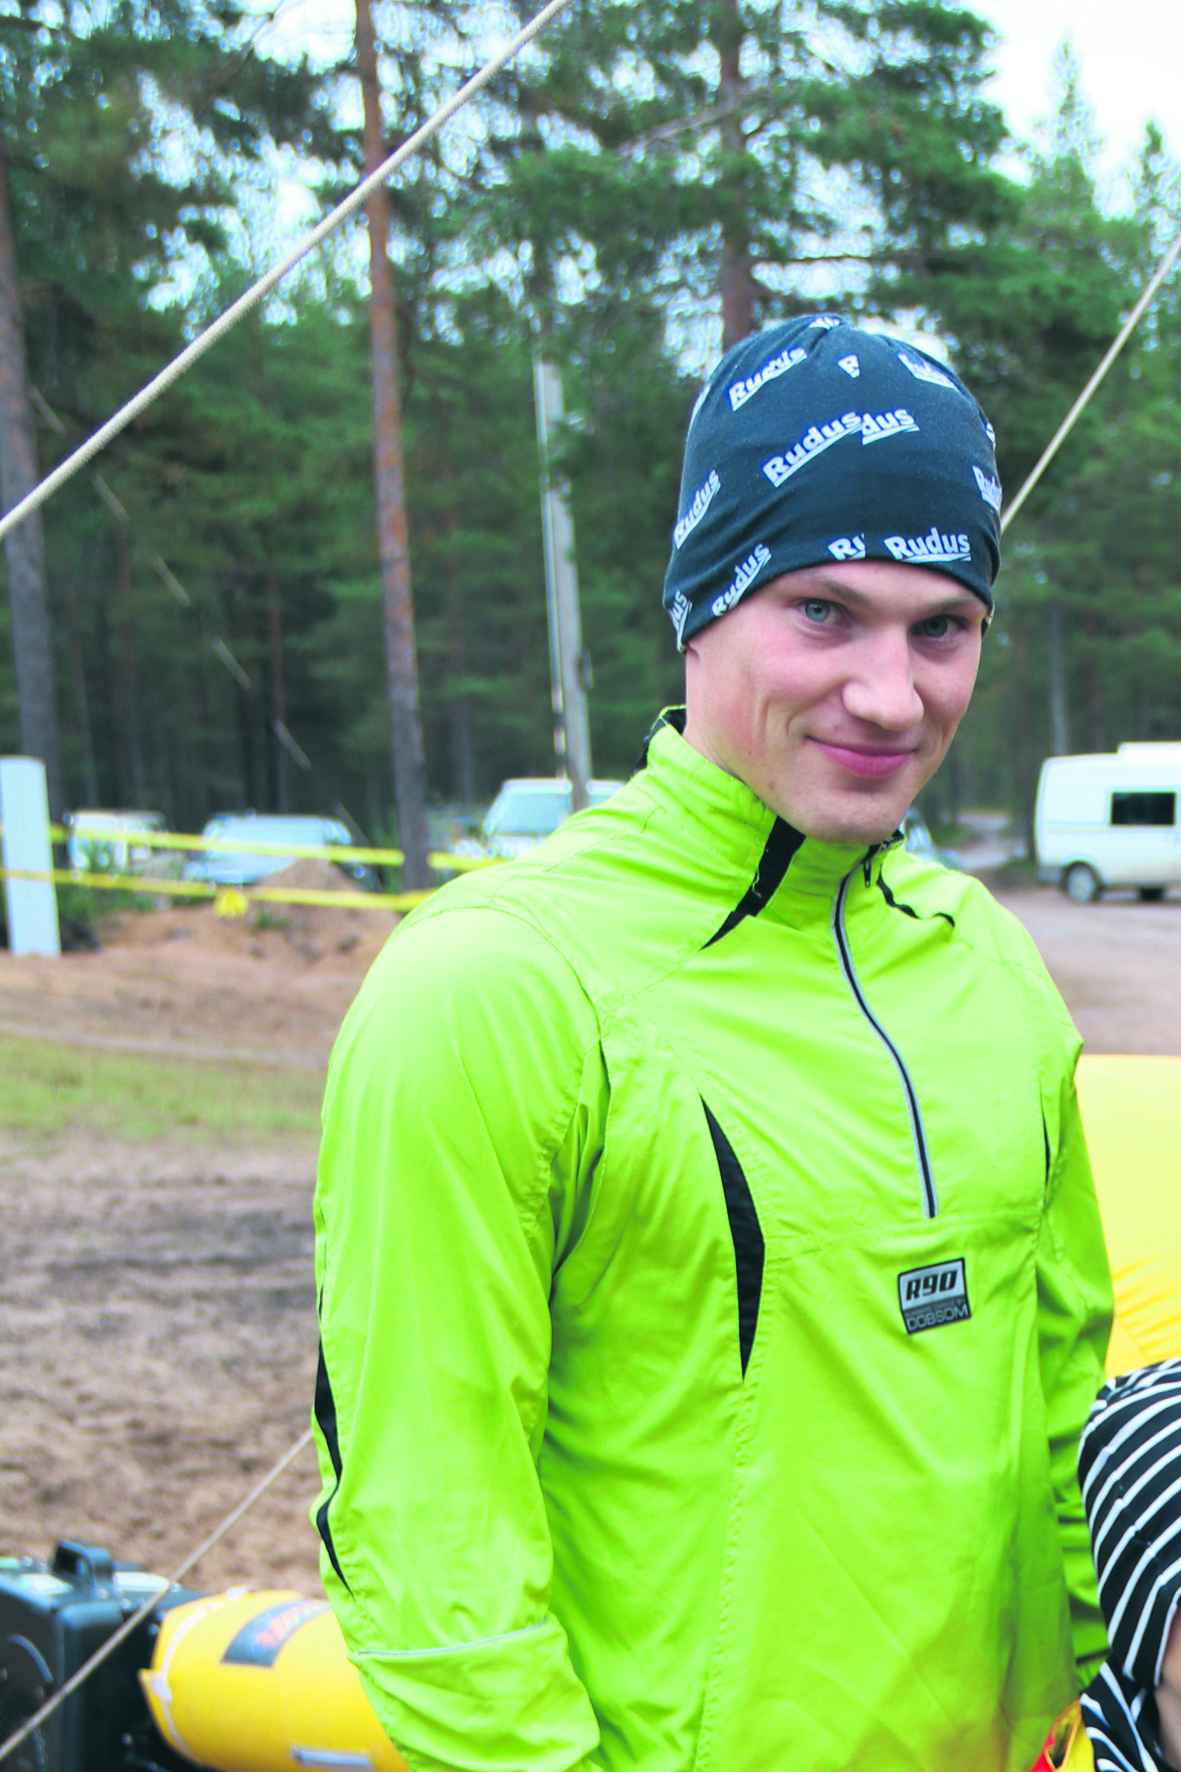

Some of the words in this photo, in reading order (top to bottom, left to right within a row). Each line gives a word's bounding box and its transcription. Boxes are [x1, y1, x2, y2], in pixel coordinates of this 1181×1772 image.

[762, 412, 862, 487] Rudus
[673, 469, 721, 549] Rudus
[883, 527, 971, 563] Rudus
[711, 543, 772, 617] Rudus
[907, 1304, 968, 1331] DOBSOM
